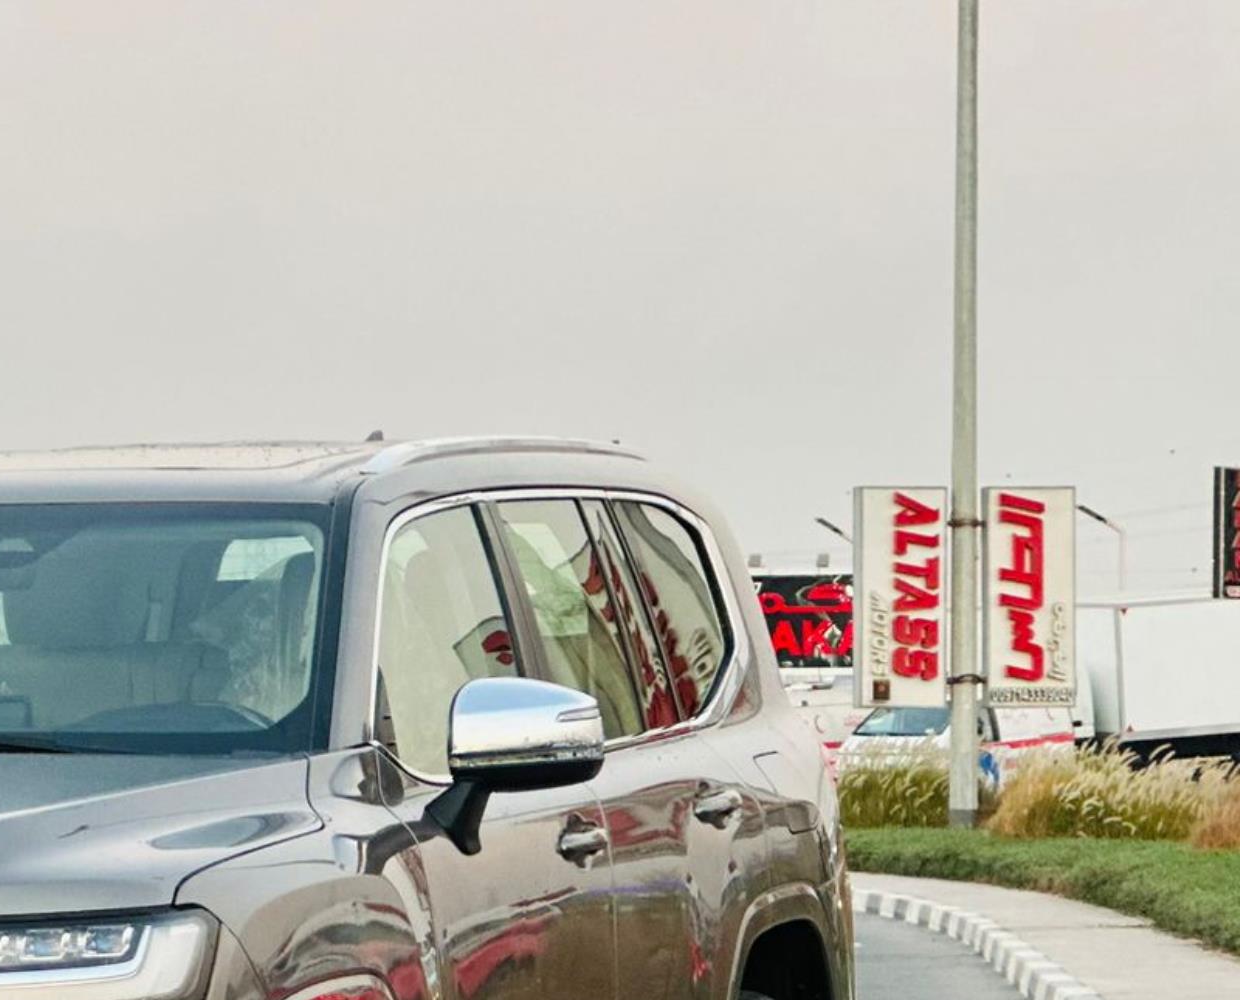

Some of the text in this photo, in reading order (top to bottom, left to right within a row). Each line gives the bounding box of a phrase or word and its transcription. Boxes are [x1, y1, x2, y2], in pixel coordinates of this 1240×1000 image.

[871, 592, 889, 678] MOTORS
[892, 491, 940, 682] ALTASS
[998, 492, 1046, 682] الطاس
